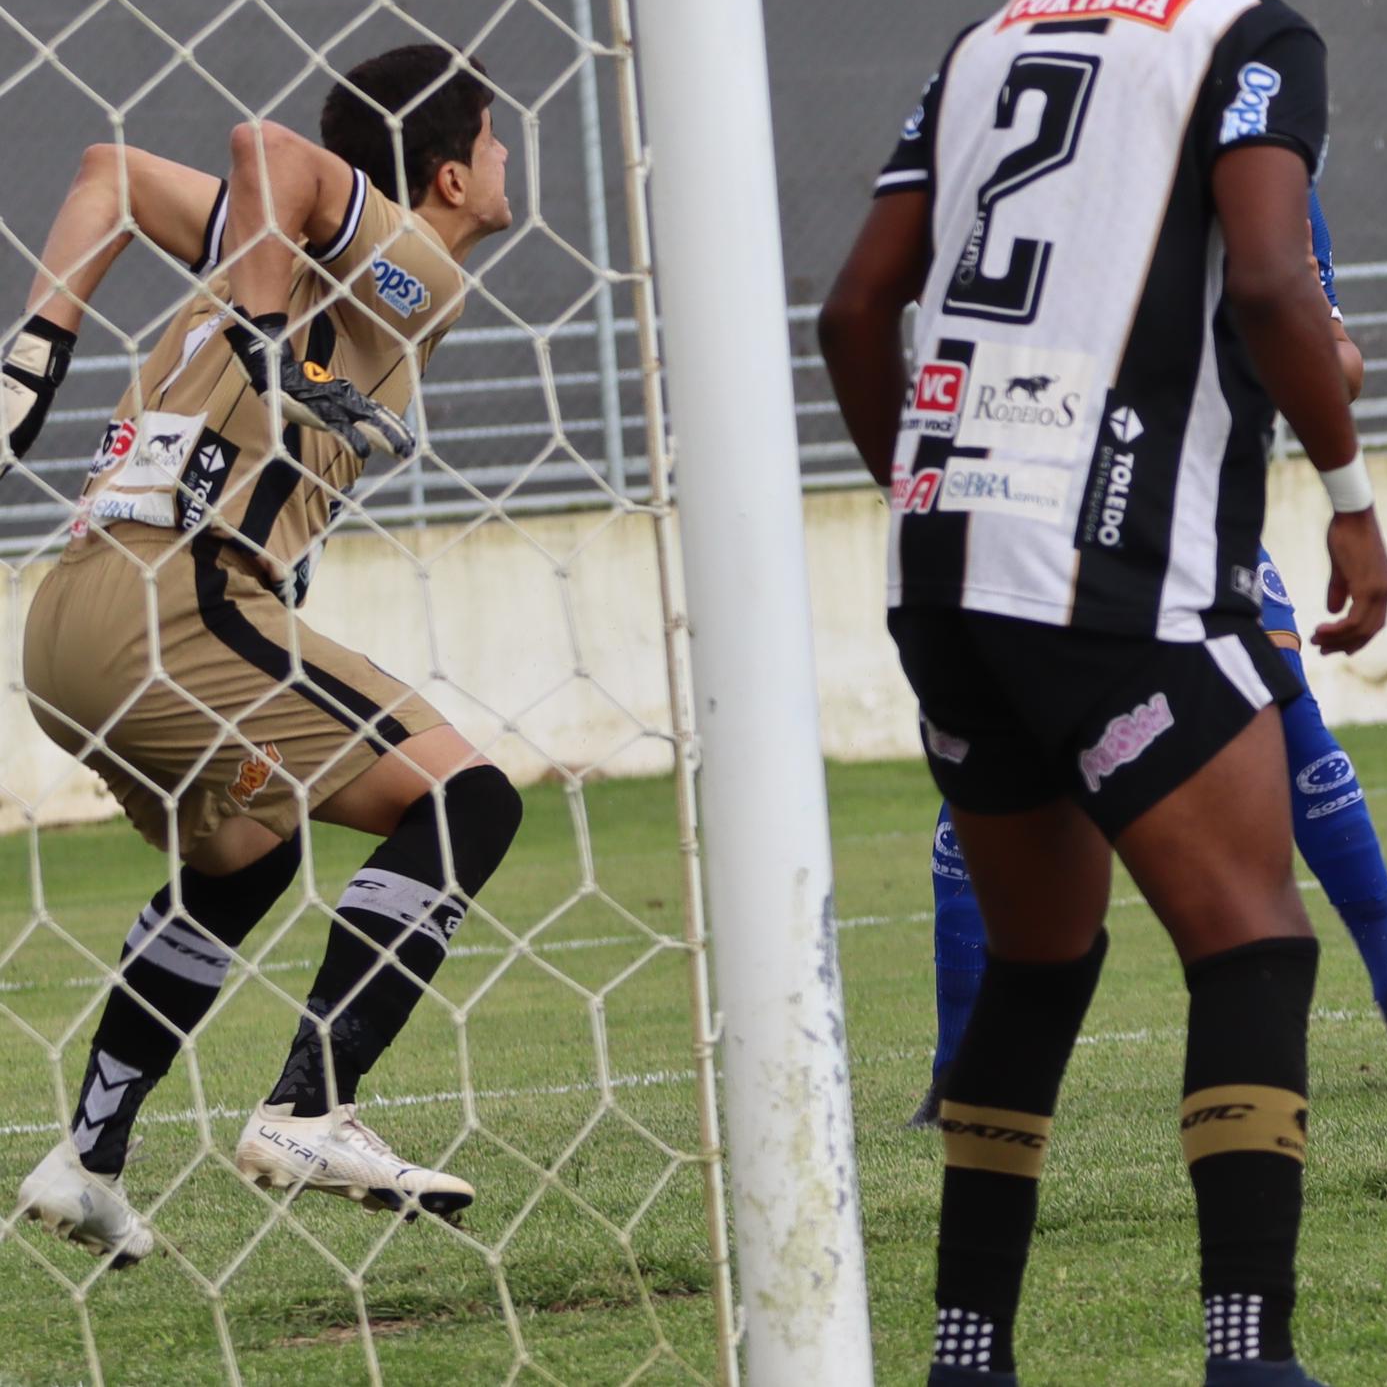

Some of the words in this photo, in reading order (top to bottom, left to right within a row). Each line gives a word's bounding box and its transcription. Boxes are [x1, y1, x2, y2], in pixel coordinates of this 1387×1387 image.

[943, 50, 1103, 325] 2
[1098, 451, 1136, 547] TOLEDO
[258, 1124, 329, 1173] ULTRA
